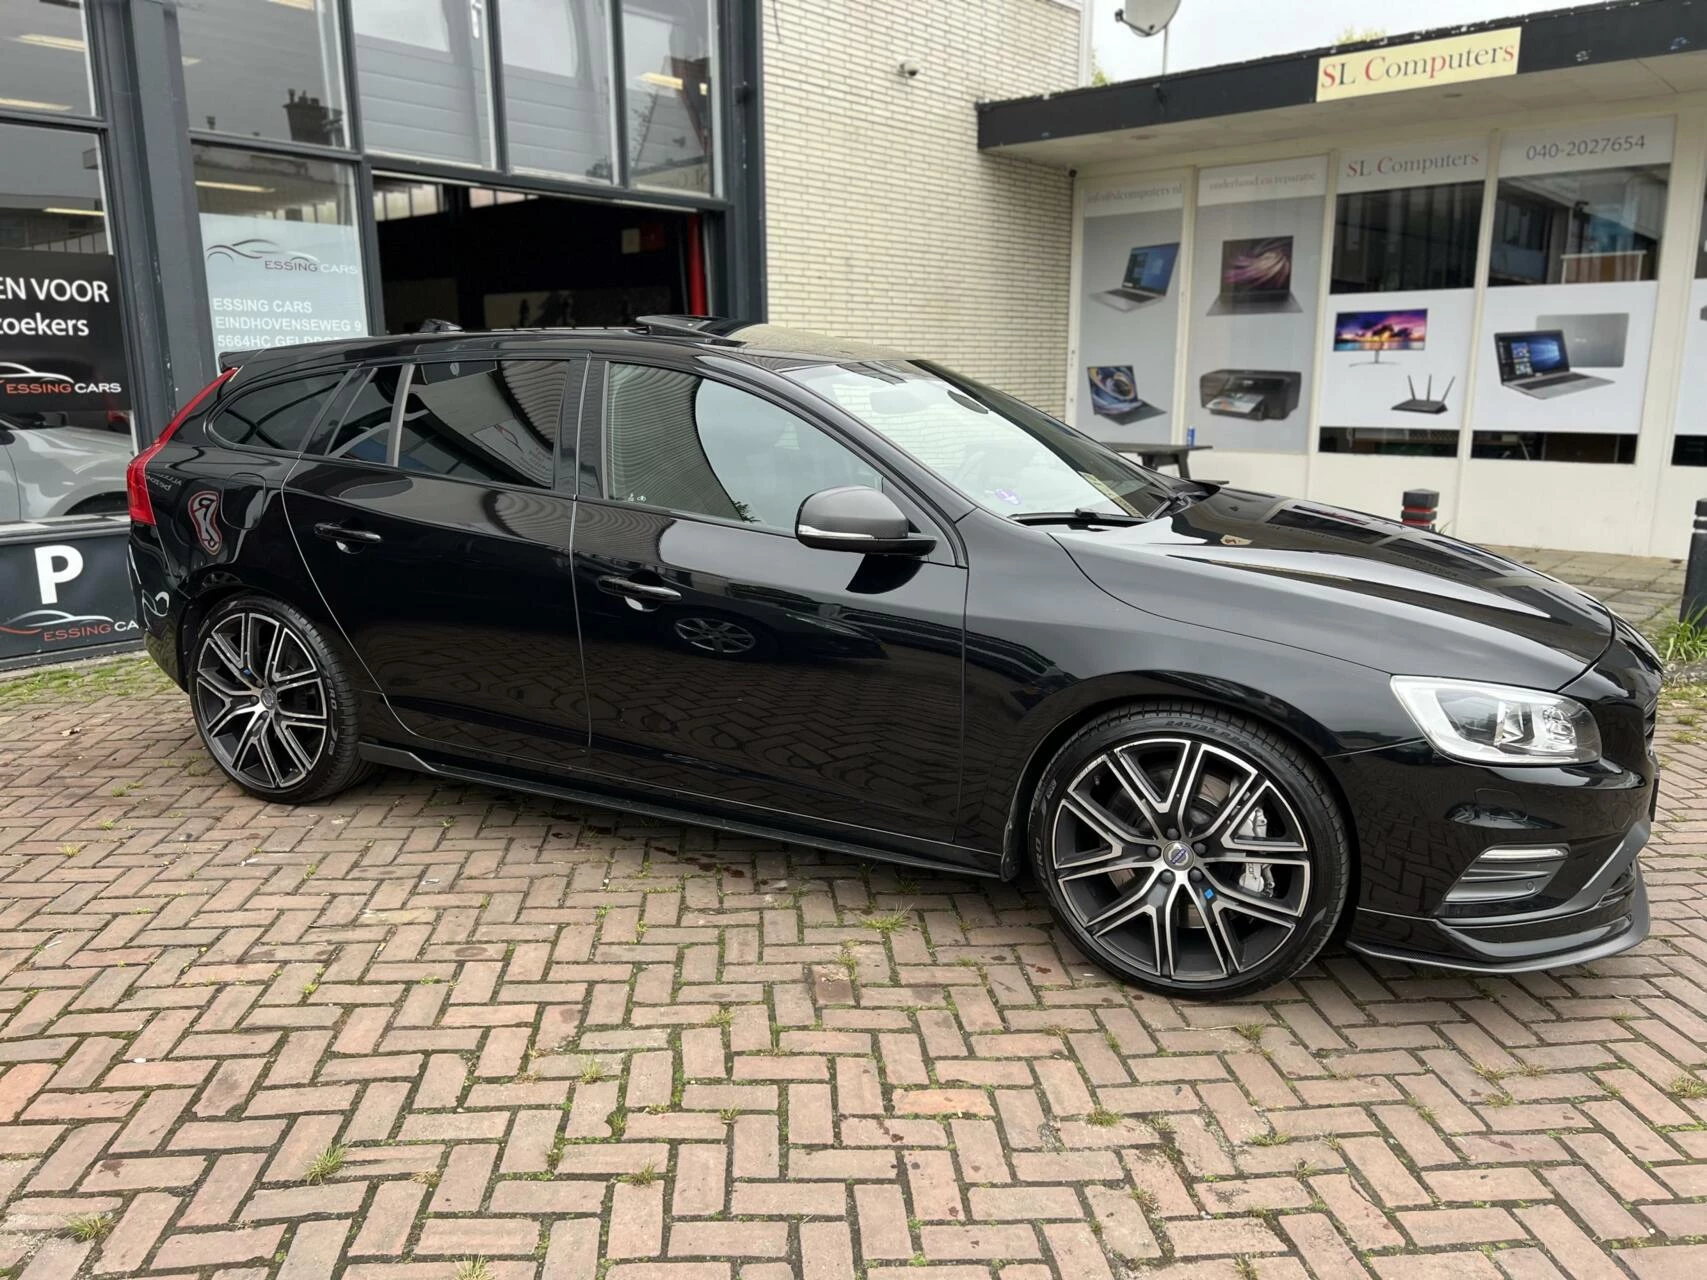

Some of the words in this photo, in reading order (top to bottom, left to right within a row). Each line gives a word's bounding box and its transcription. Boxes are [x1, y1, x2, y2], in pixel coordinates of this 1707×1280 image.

[1321, 62, 1356, 89] SL
[1364, 45, 1515, 80] Computers
[1526, 134, 1646, 161] 040-2027654
[1346, 159, 1372, 178] SL
[1377, 153, 1480, 177] Computers
[264, 260, 318, 273] ESSING
[320, 263, 358, 275] CARS
[30, 278, 110, 303] VOOR
[213, 298, 269, 312] ESSING
[273, 300, 312, 314] CARS
[215, 316, 352, 332] EINDHOVENSEWEG
[353, 320, 362, 333] 9
[217, 335, 270, 348] 5664HC
[6, 383, 72, 394] ESSING
[74, 382, 122, 394] CARS
[34, 545, 84, 605] P
[44, 624, 112, 642] ESSING
